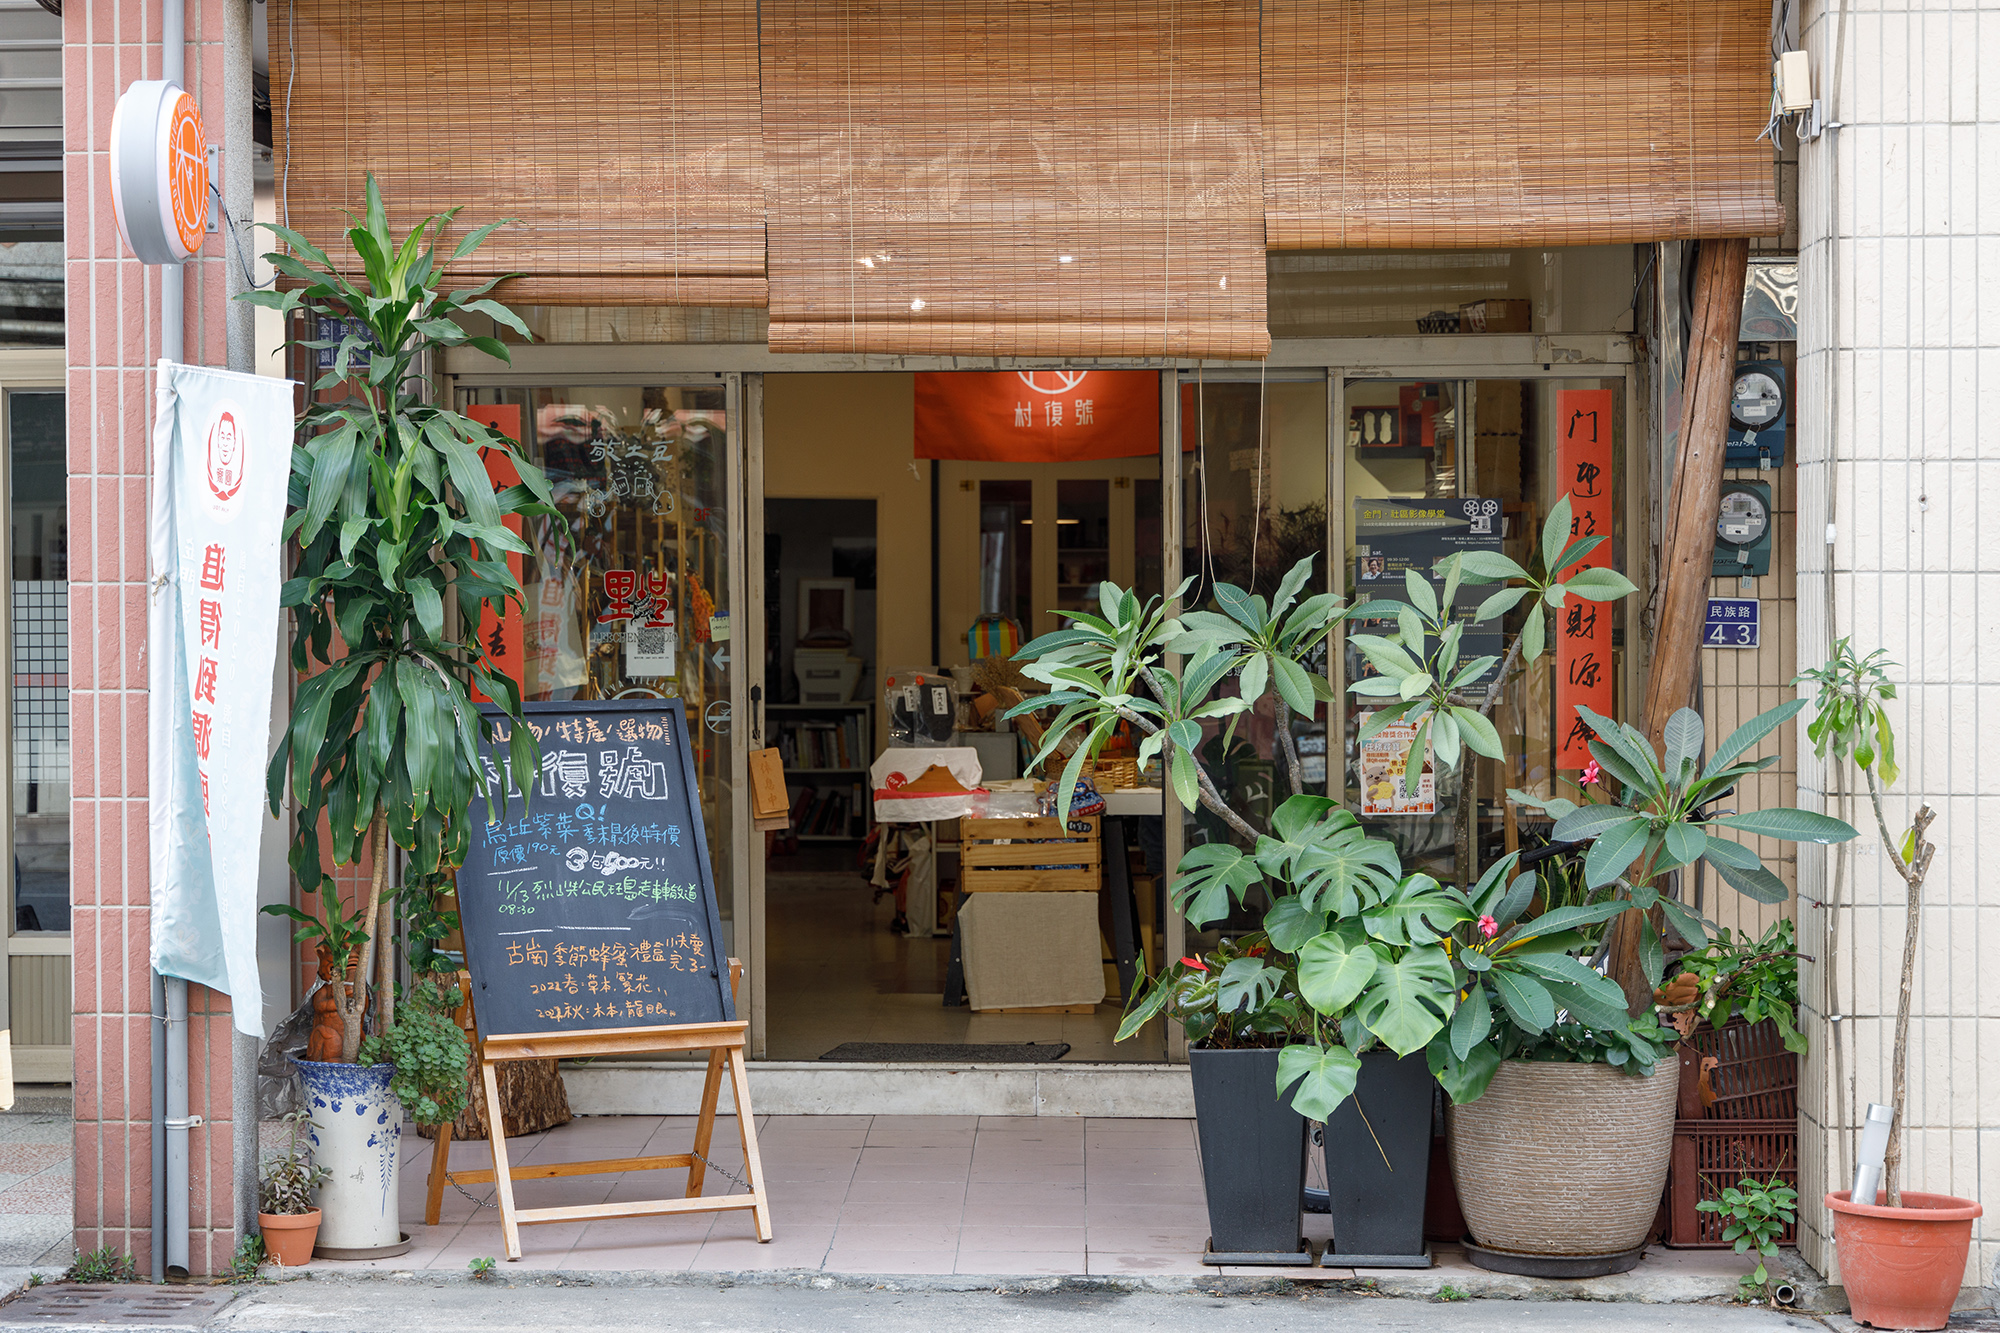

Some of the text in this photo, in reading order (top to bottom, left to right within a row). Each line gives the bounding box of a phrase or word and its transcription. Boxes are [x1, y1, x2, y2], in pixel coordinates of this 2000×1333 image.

[170, 96, 209, 169] VIVA VILLAGES GOODS
[1014, 399, 1094, 427] 村復號
[693, 507, 711, 522] 3F
[1710, 605, 1751, 618] 民族路
[695, 629, 712, 644] 2F
[1709, 624, 1751, 645] 43
[630, 676, 680, 699] VILLAGE
[695, 749, 711, 763] 1F
[760, 760, 778, 807] 休息中
[493, 842, 561, 867] 原價190元
[498, 879, 530, 903] 11/13
[498, 904, 535, 915] 08:30
